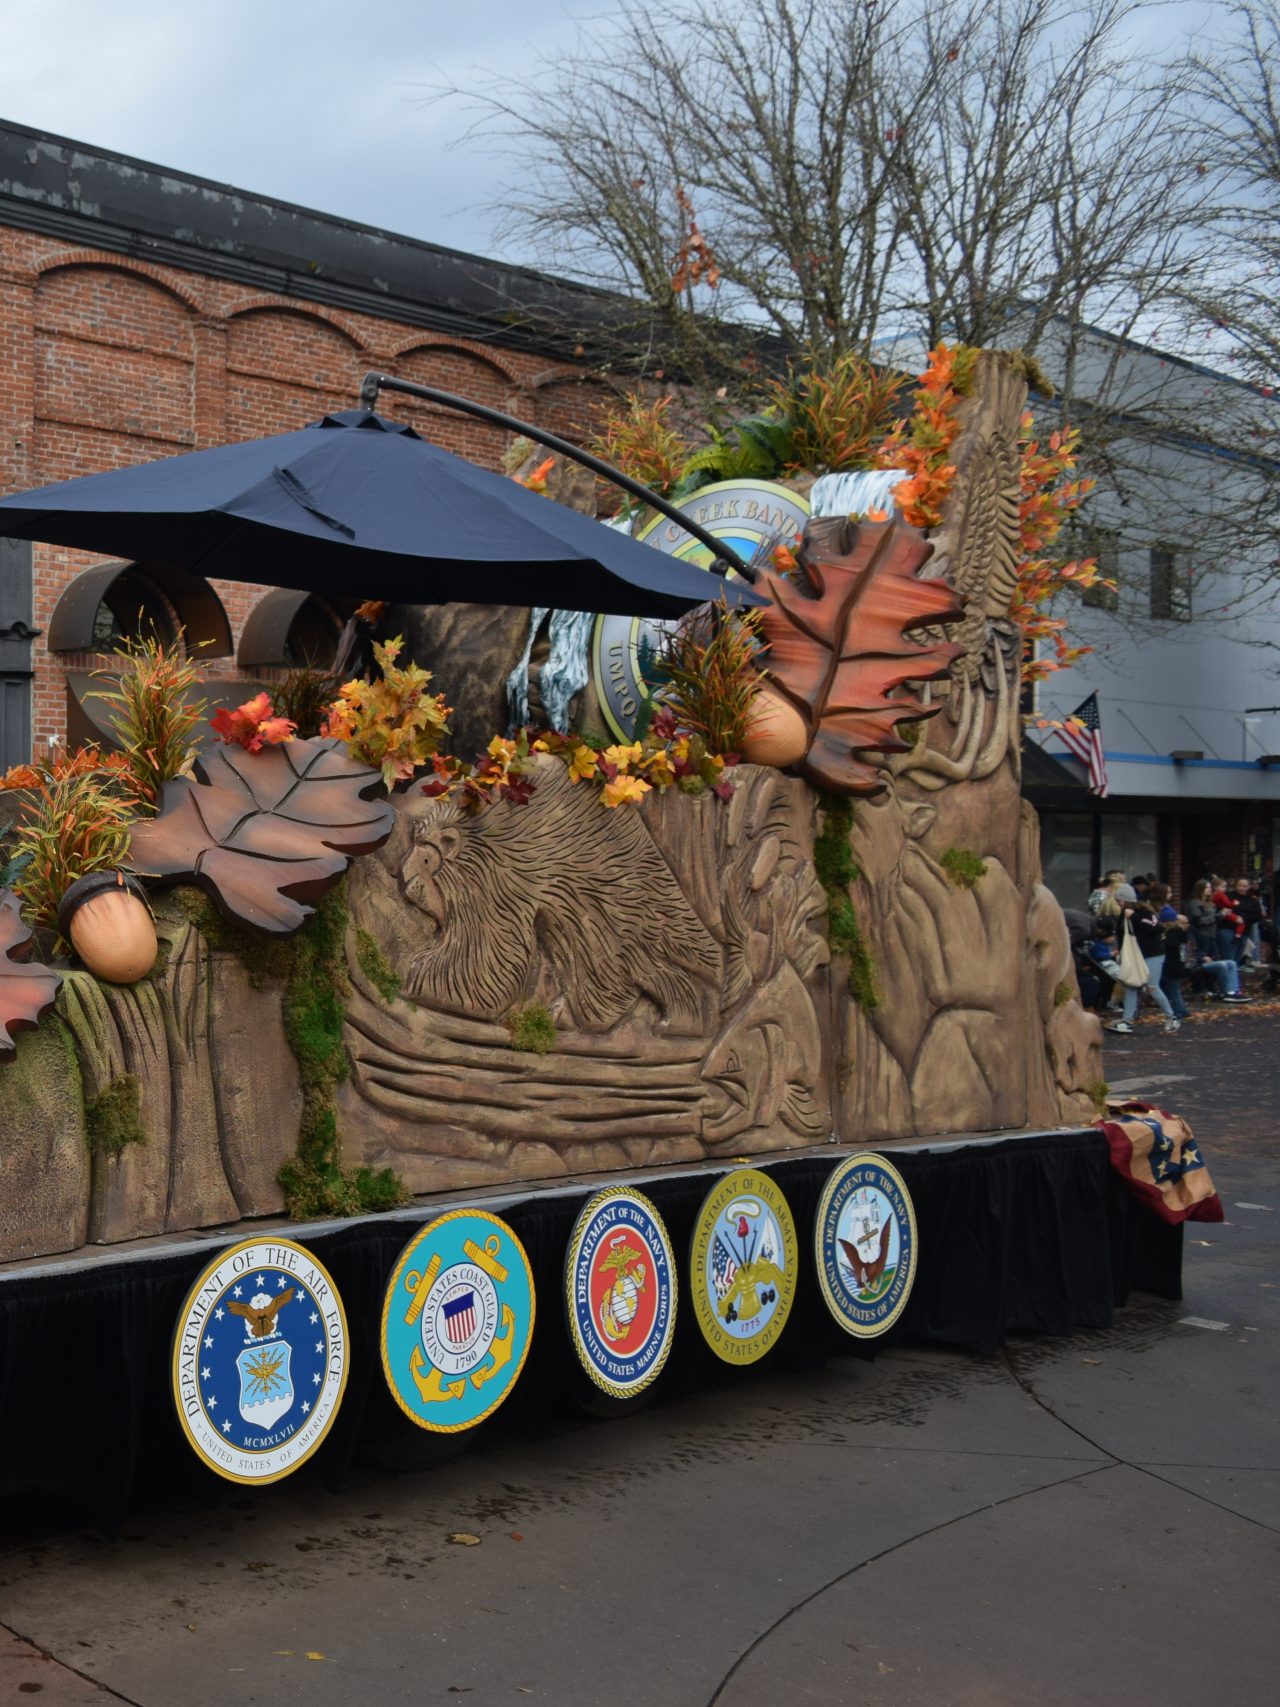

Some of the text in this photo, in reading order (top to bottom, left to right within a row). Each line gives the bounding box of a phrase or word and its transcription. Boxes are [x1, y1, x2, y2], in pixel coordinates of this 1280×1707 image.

[665, 499, 799, 543] CEEK BAND
[608, 640, 637, 727] UMPQ
[696, 1181, 738, 1271] DEPARTMENT
[743, 1178, 755, 1190] OF
[775, 1204, 793, 1245] ARMY
[826, 1171, 908, 1243] DEPARTMENT OF THE NAVY
[578, 1207, 665, 1304] DEPARTMENT OF THE NAVY
[826, 1248, 910, 1322] UNITED STATES OF AMERICA
[425, 1268, 495, 1365] UNITED STATES COAST GUARD
[445, 1287, 469, 1301] SEMPER
[582, 1284, 668, 1376] UNITED STATES MARINE CORPS
[699, 1257, 794, 1356] UNITED STATES OF AMERICA
[741, 1319, 760, 1333] 1775
[181, 1247, 343, 1418] DEPARTMENT OF THE AIR FORCE
[455, 1350, 477, 1370] 1790
[202, 1402, 331, 1470] UNITED STATES OF AMERICA
[243, 1423, 295, 1448] MCMXLVII
